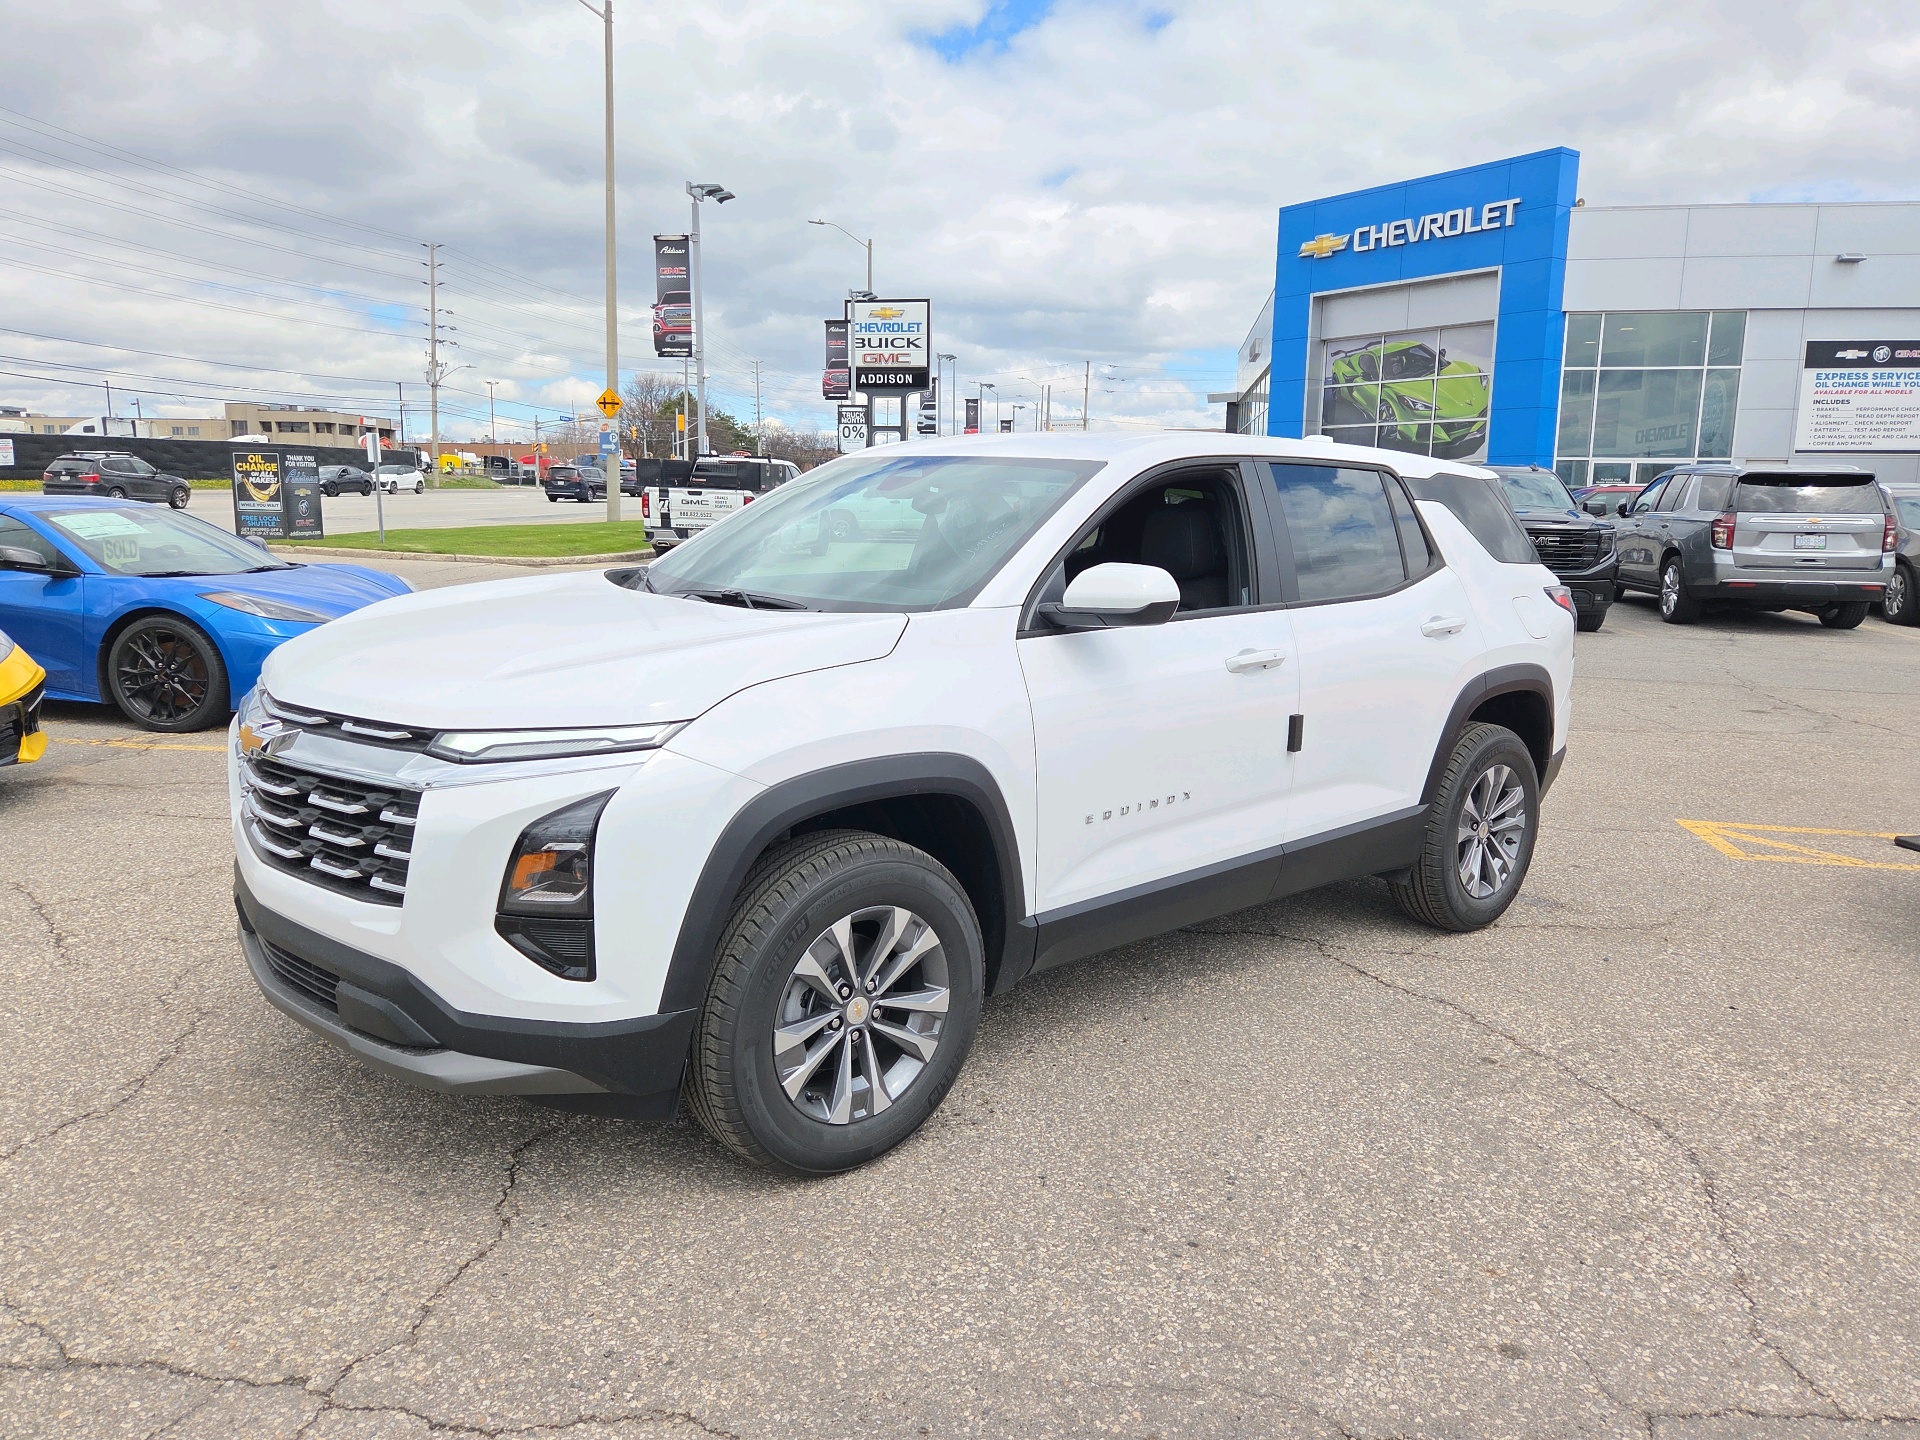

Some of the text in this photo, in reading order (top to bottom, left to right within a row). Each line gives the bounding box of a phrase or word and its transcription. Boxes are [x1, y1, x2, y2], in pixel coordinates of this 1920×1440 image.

[1353, 197, 1522, 252] CHEVROLET
[659, 266, 687, 275] GMC
[855, 337, 922, 349] BUICK
[862, 353, 912, 364] GMC
[859, 374, 913, 384] ADDISON
[1815, 372, 1920, 381] EXPRESS SERVICE
[842, 425, 865, 439] 0%
[247, 454, 265, 463] OIL
[286, 454, 303, 462] THANK
[236, 462, 278, 472] CHANGE
[1528, 536, 1561, 546] MC
[105, 540, 138, 560] SOLD
[1084, 790, 1191, 825] EQUINOX
